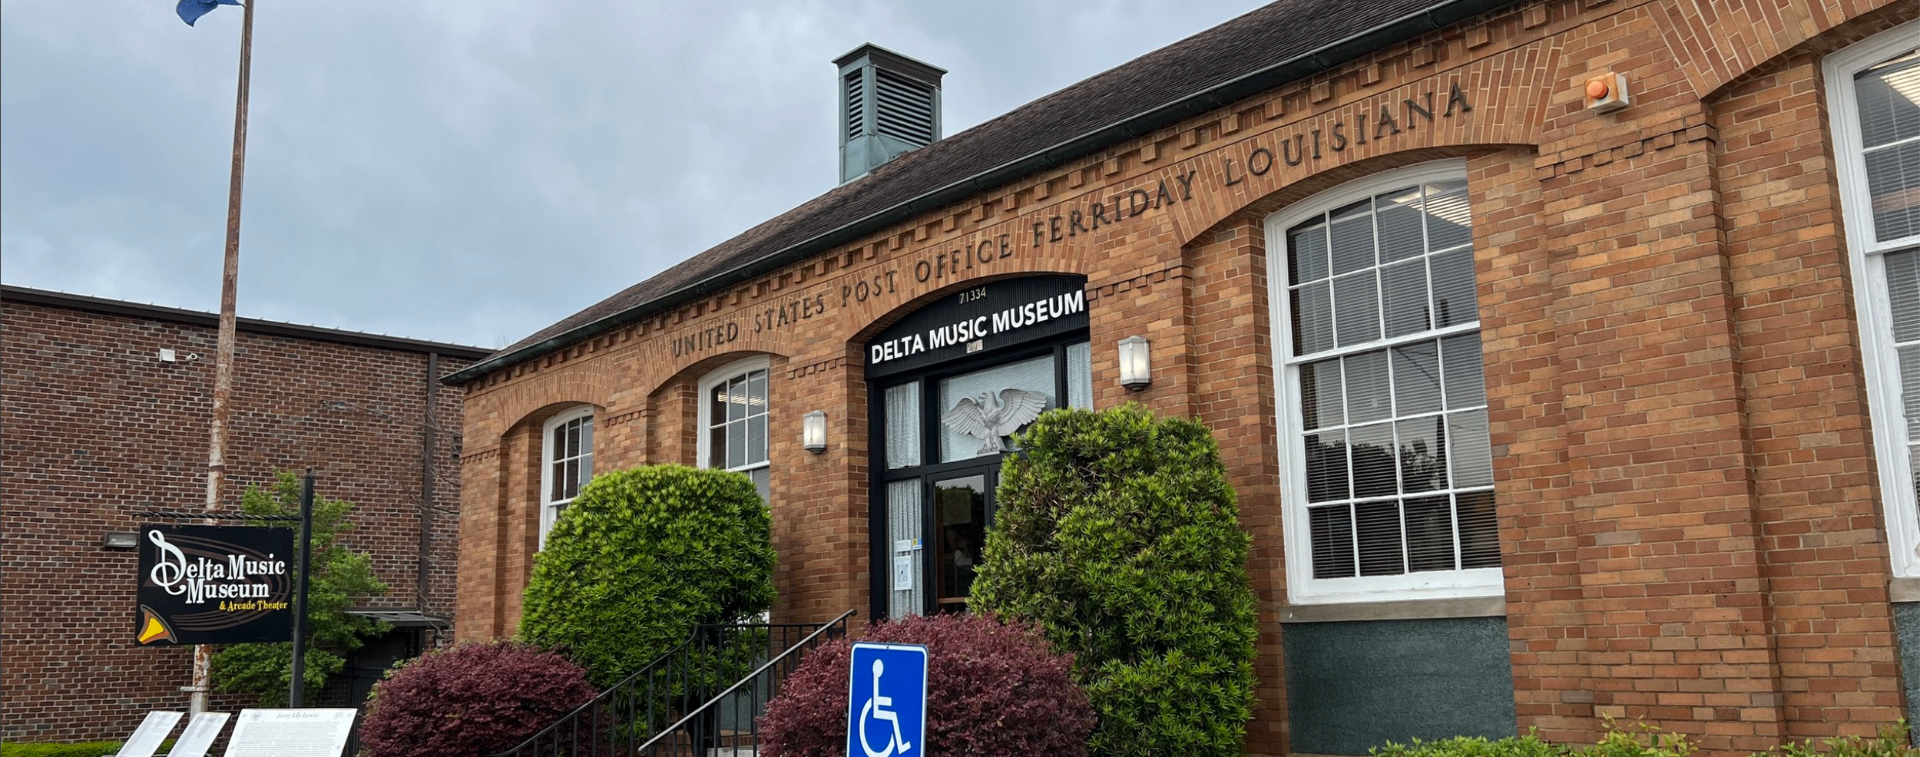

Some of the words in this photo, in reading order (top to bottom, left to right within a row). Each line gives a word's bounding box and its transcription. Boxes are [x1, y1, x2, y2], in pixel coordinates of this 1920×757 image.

[672, 322, 738, 358] UNITED
[754, 294, 825, 333] STATES
[841, 269, 897, 308] POST
[914, 233, 1012, 283] OFFICE
[1032, 170, 1196, 248] FERRIDAY
[1224, 81, 1473, 187] LOUISIANA
[959, 286, 987, 305] 71334
[871, 333, 925, 364] DELTA
[929, 315, 988, 349] MUSIC
[992, 289, 1084, 334] MUSEUM
[148, 529, 225, 596] Delta
[226, 553, 286, 580] Music
[185, 578, 270, 604] Museum
[219, 601, 226, 611] &
[227, 600, 256, 612] Arcade
[257, 600, 288, 611] Theater
